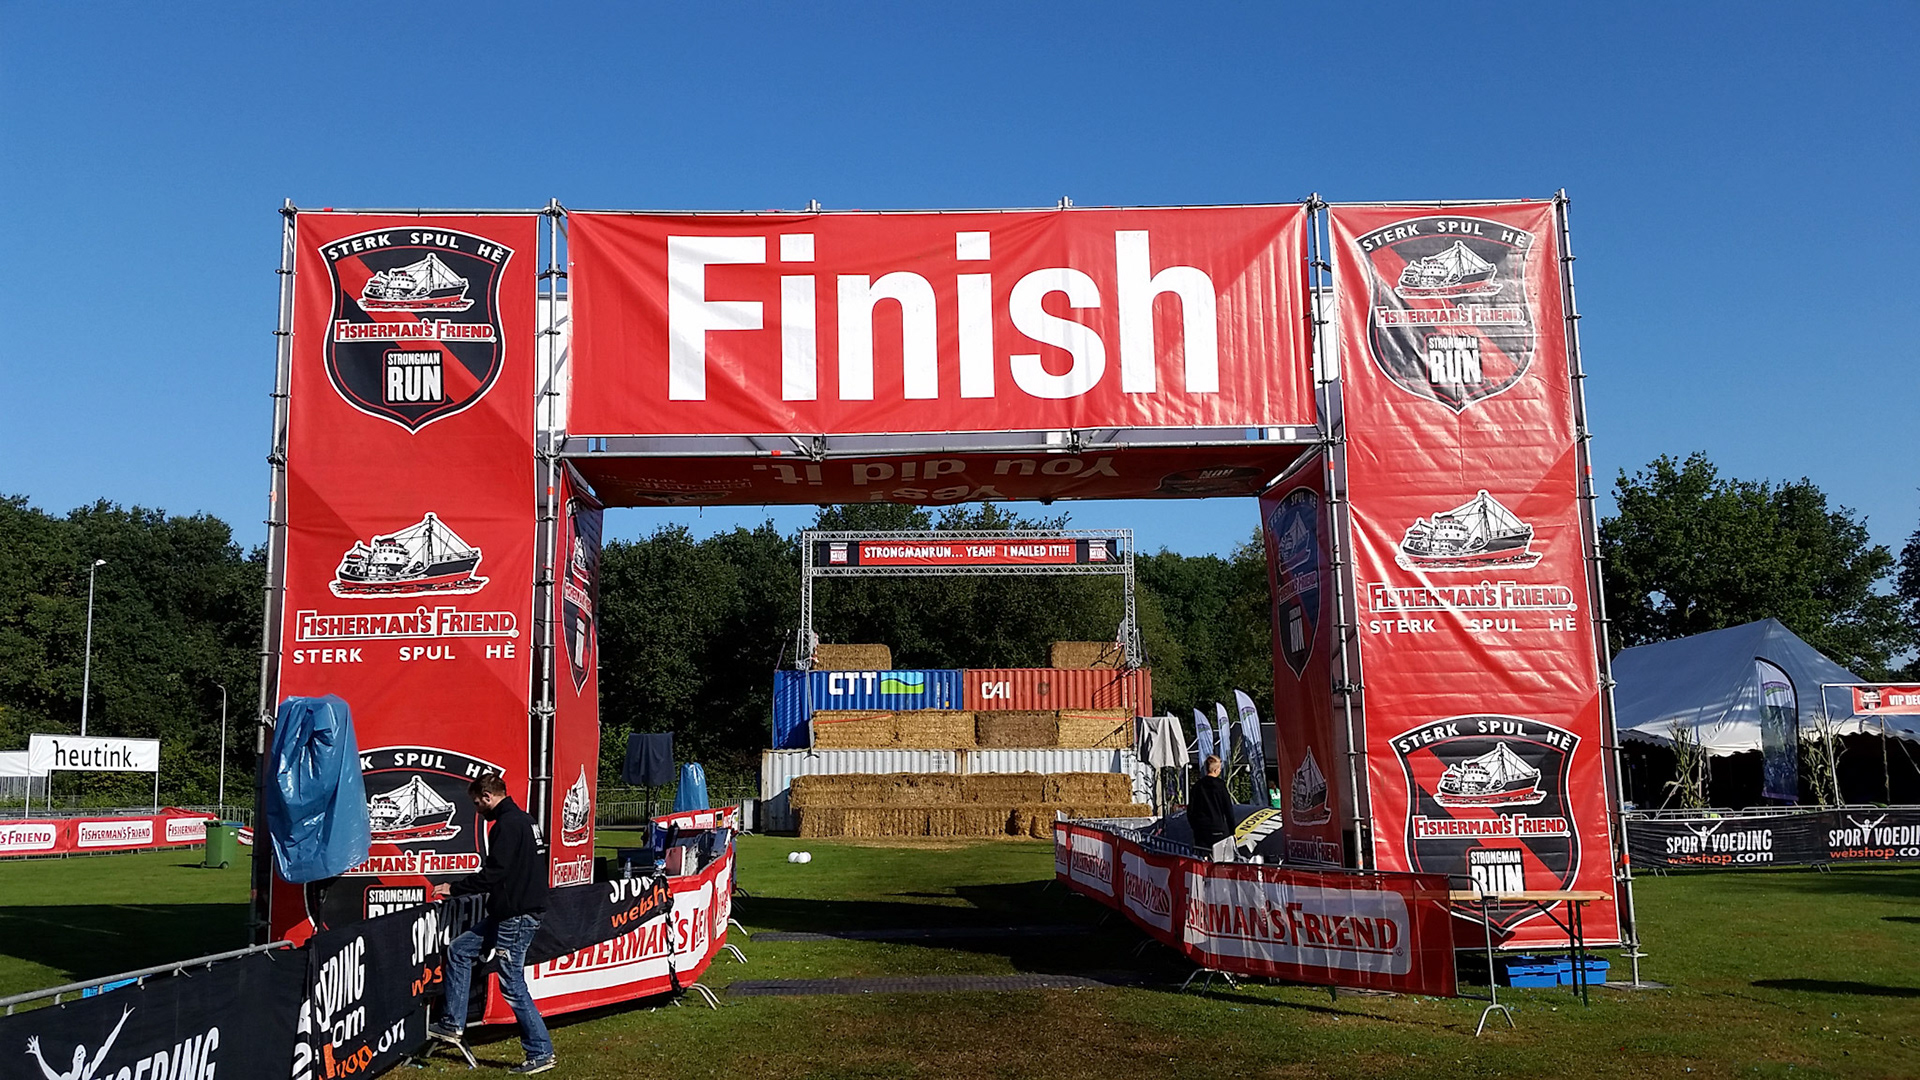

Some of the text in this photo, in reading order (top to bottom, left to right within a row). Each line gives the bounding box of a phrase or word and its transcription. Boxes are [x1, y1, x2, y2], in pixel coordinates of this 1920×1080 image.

[1362, 224, 1420, 251] STERK
[1437, 221, 1483, 236] SPUL
[328, 232, 505, 263] STERK SPUL HÈ
[667, 230, 1220, 401] Finish
[1471, 306, 1524, 323] FRIEND
[336, 319, 493, 340] FISHERMAN'S FRIEND
[388, 353, 440, 365] STRONGMAN
[1430, 351, 1481, 383] RUN
[388, 366, 441, 401] RUN
[852, 459, 965, 485] did
[994, 458, 1120, 477] You
[966, 545, 996, 557] YEAH!
[1010, 545, 1046, 557] NAILED
[1501, 583, 1570, 609] FRIEND
[299, 608, 514, 639] FISHERMAN'S FRIEND
[1370, 615, 1577, 634] STERK SPUL HÈ
[292, 641, 515, 664] STERK SPUL HÈ
[828, 672, 876, 695] CTT
[982, 682, 1010, 699] CAI
[1889, 695, 1904, 706] VIP
[1399, 721, 1571, 753] STERK SPUL HÈ
[394, 753, 446, 770] SPUL
[1414, 815, 1566, 838] FISHERMAN'S FRIEND
[8, 831, 51, 844] FRIEND
[420, 852, 479, 873] FRIEND
[1471, 851, 1521, 864] STRONGMAN
[1667, 852, 1774, 866] webshop.com
[369, 888, 424, 903] STRONGMAN
[1285, 903, 1399, 949] FRIEND
